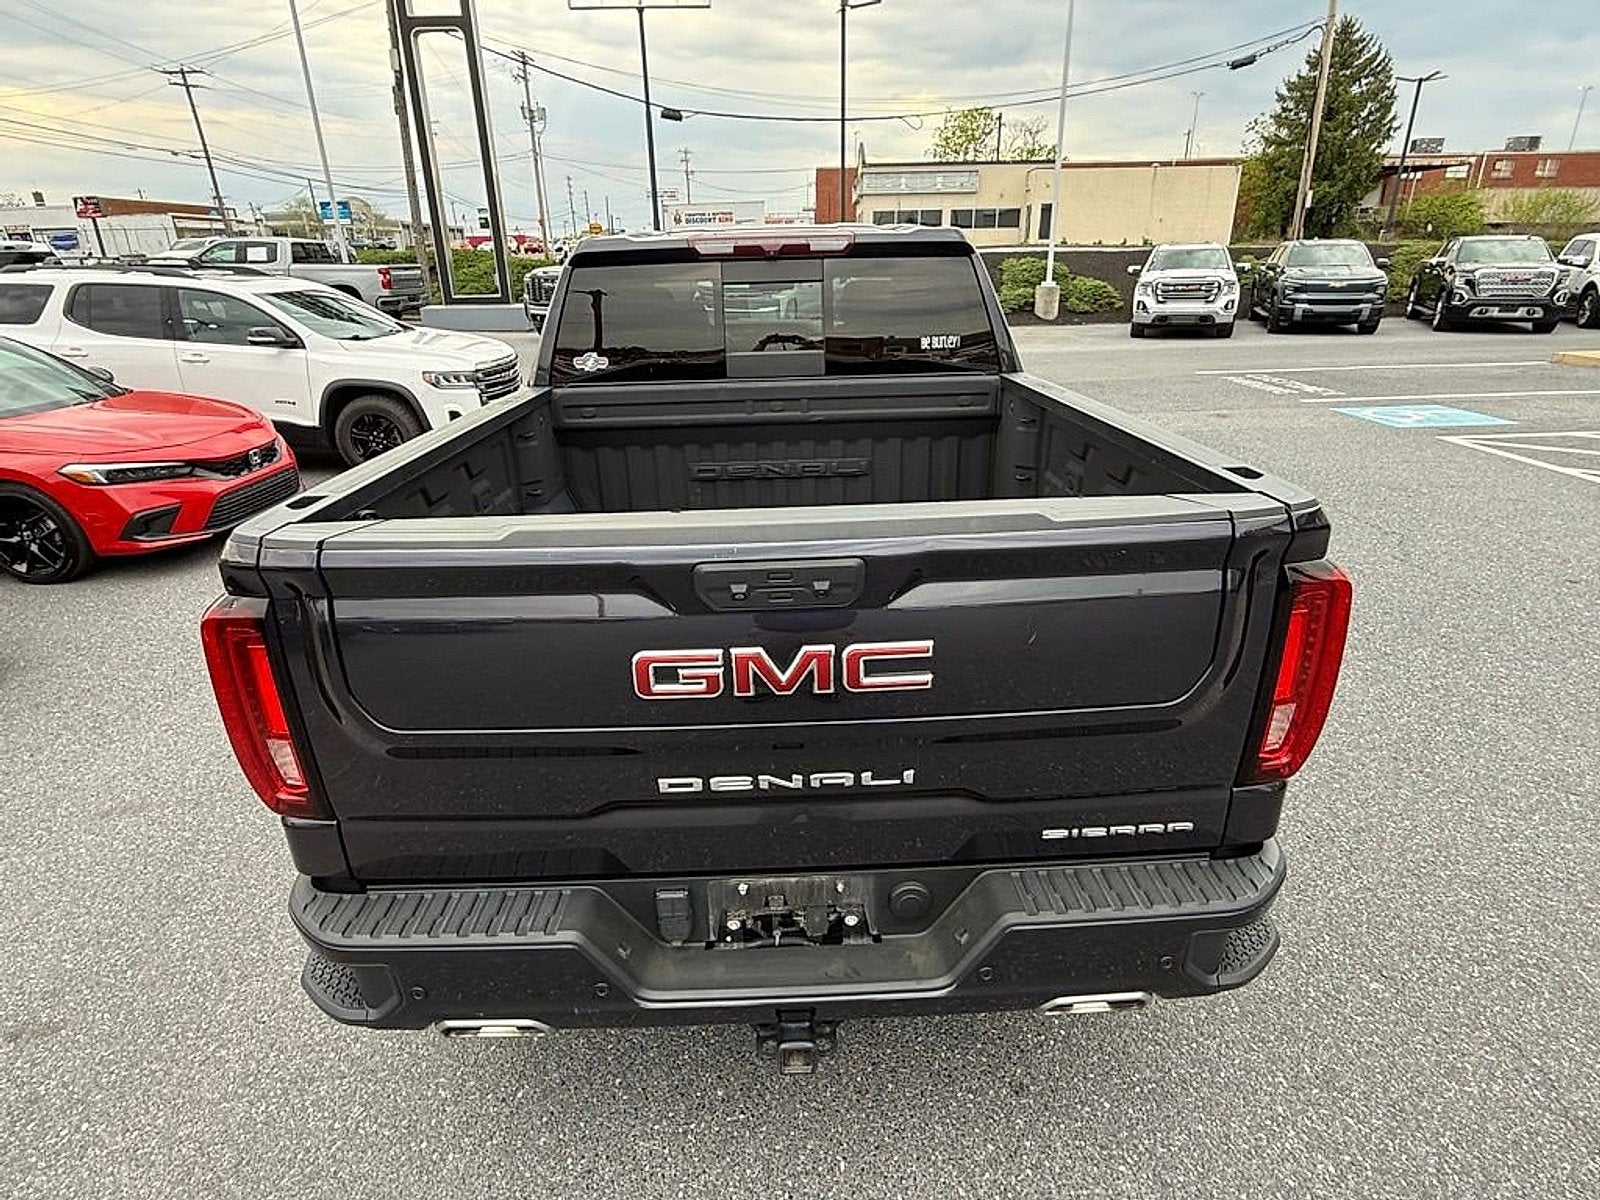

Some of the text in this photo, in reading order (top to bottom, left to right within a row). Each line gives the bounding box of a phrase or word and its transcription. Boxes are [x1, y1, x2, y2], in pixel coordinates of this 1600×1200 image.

[688, 458, 871, 480] DENALI
[632, 639, 934, 699] GMC
[657, 769, 915, 793] DENALI
[1041, 822, 1194, 839] SIERRA
